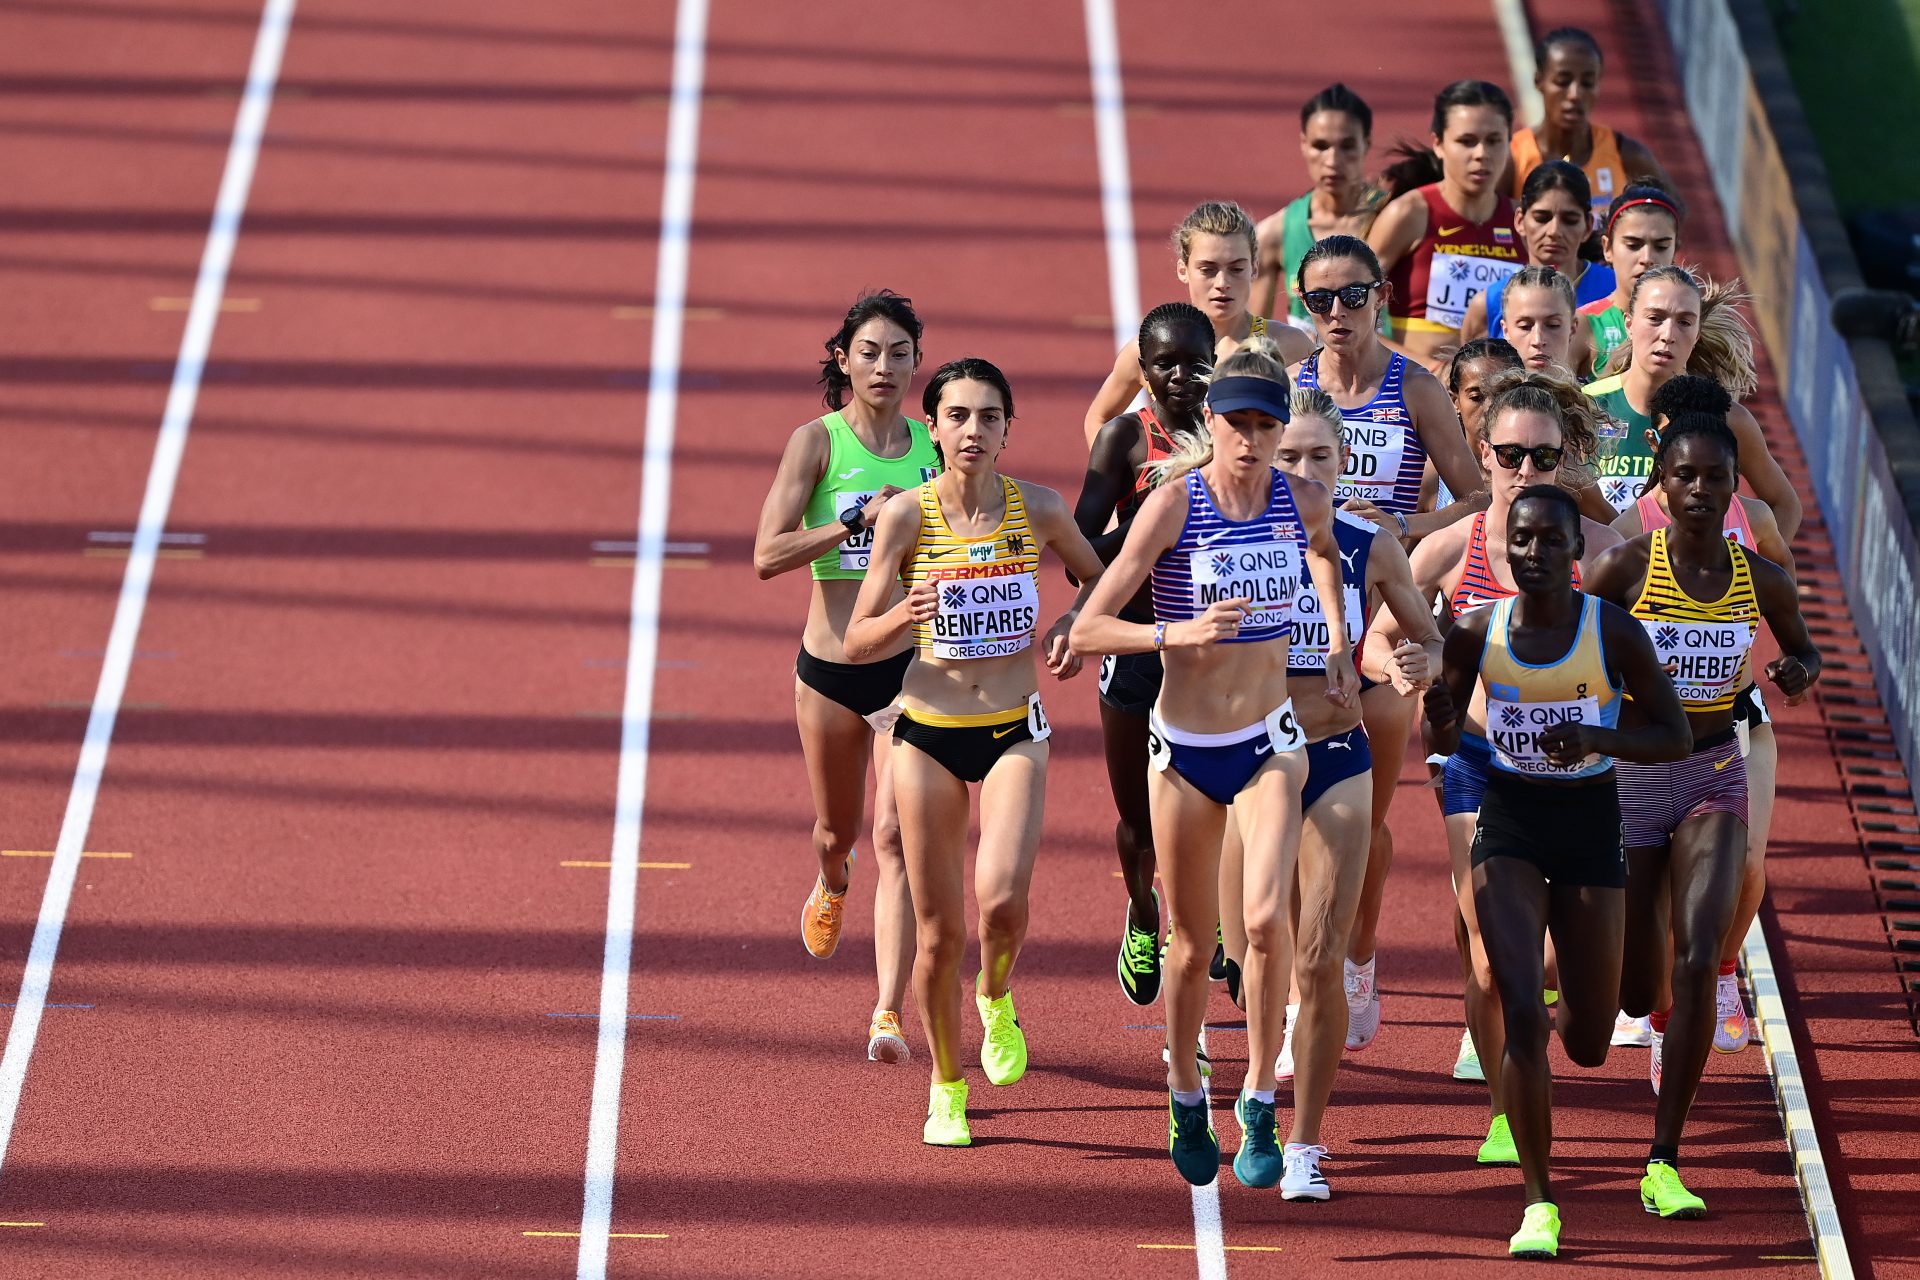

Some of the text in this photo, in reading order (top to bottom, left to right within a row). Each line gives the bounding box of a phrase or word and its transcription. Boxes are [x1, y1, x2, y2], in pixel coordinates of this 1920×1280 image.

[926, 561, 1026, 581] GERMANY
[1239, 550, 1288, 572] QNB
[971, 582, 1023, 604] QNB
[934, 606, 1034, 637] BENFARES
[949, 640, 1021, 658] OREGON22
[1684, 629, 1736, 648] QNB
[1667, 654, 1742, 679] CHEBET
[1529, 706, 1584, 725] QNB
[1279, 711, 1298, 746] 9
